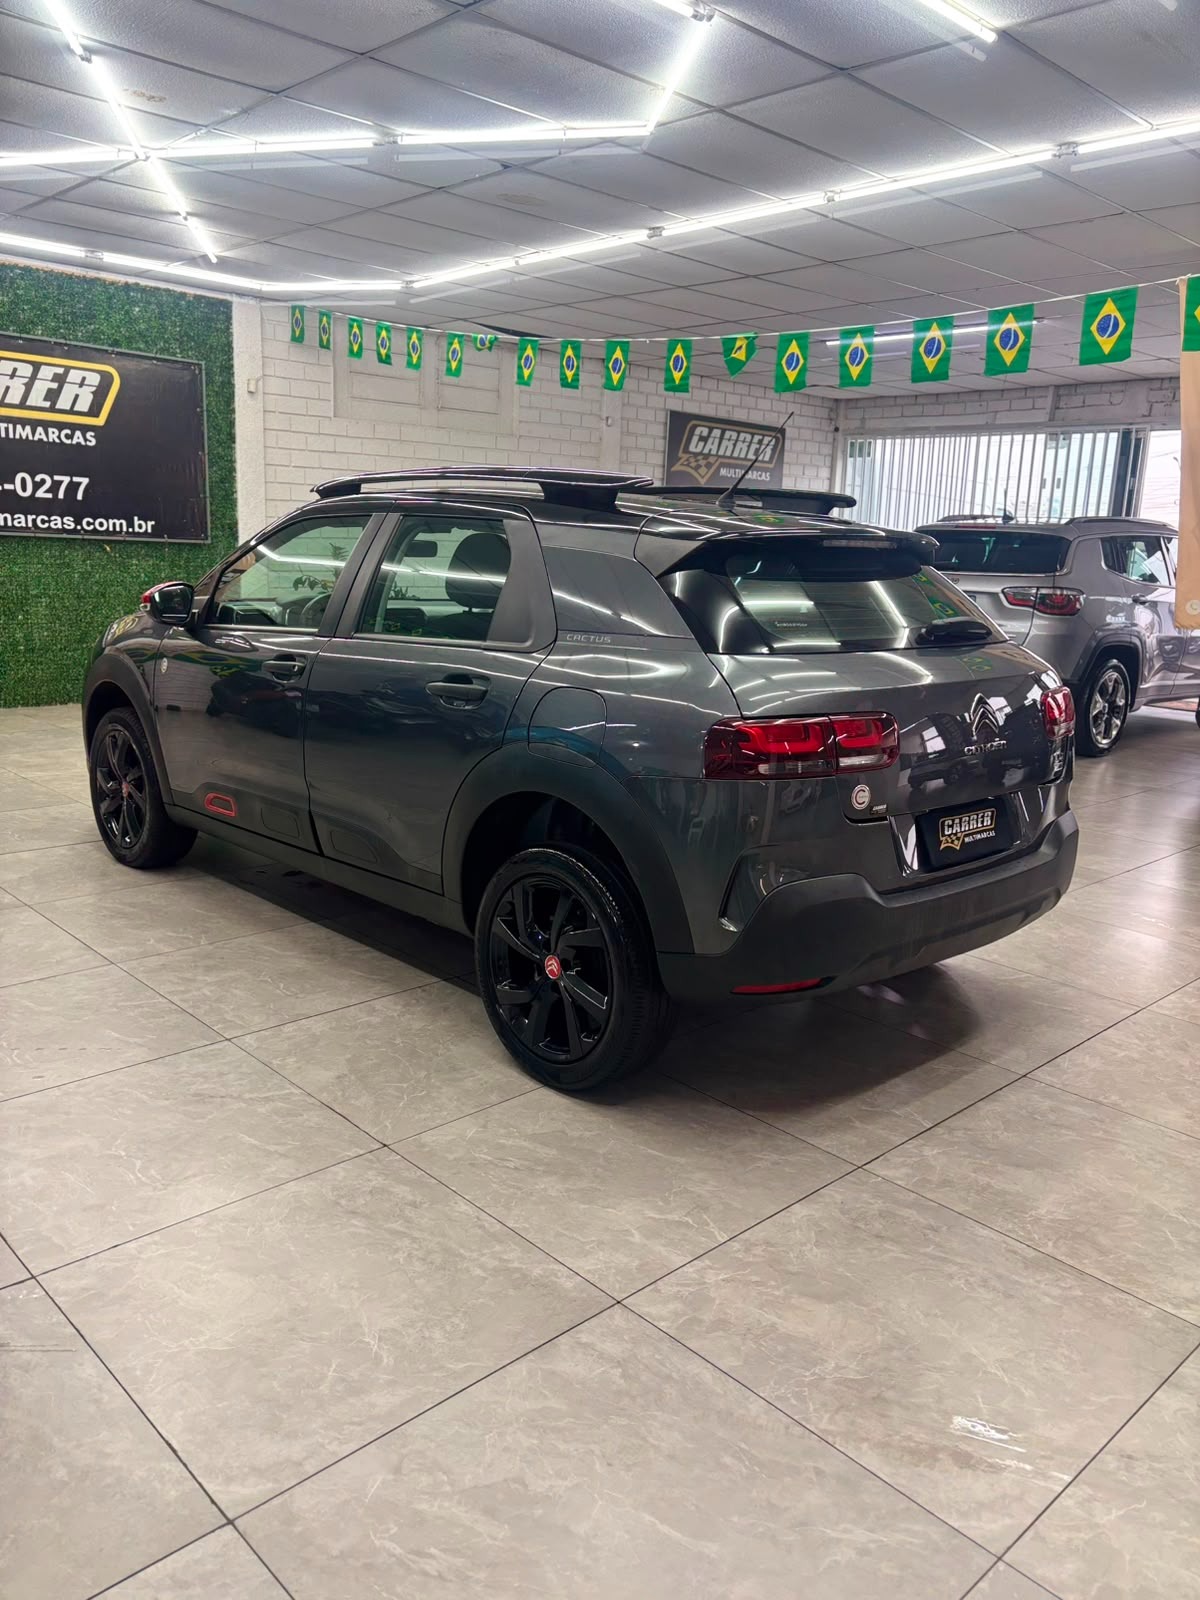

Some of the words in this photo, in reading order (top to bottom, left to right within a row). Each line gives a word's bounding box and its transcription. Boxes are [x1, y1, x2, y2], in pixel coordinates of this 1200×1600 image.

[0, 360, 101, 412] RER
[0, 423, 96, 446] TIMARCAS
[689, 426, 776, 461] CARRER
[0, 472, 90, 501] -0277
[0, 512, 155, 533] marcas.com.br
[566, 633, 611, 643] CACTUS
[944, 811, 992, 835] CARRER
